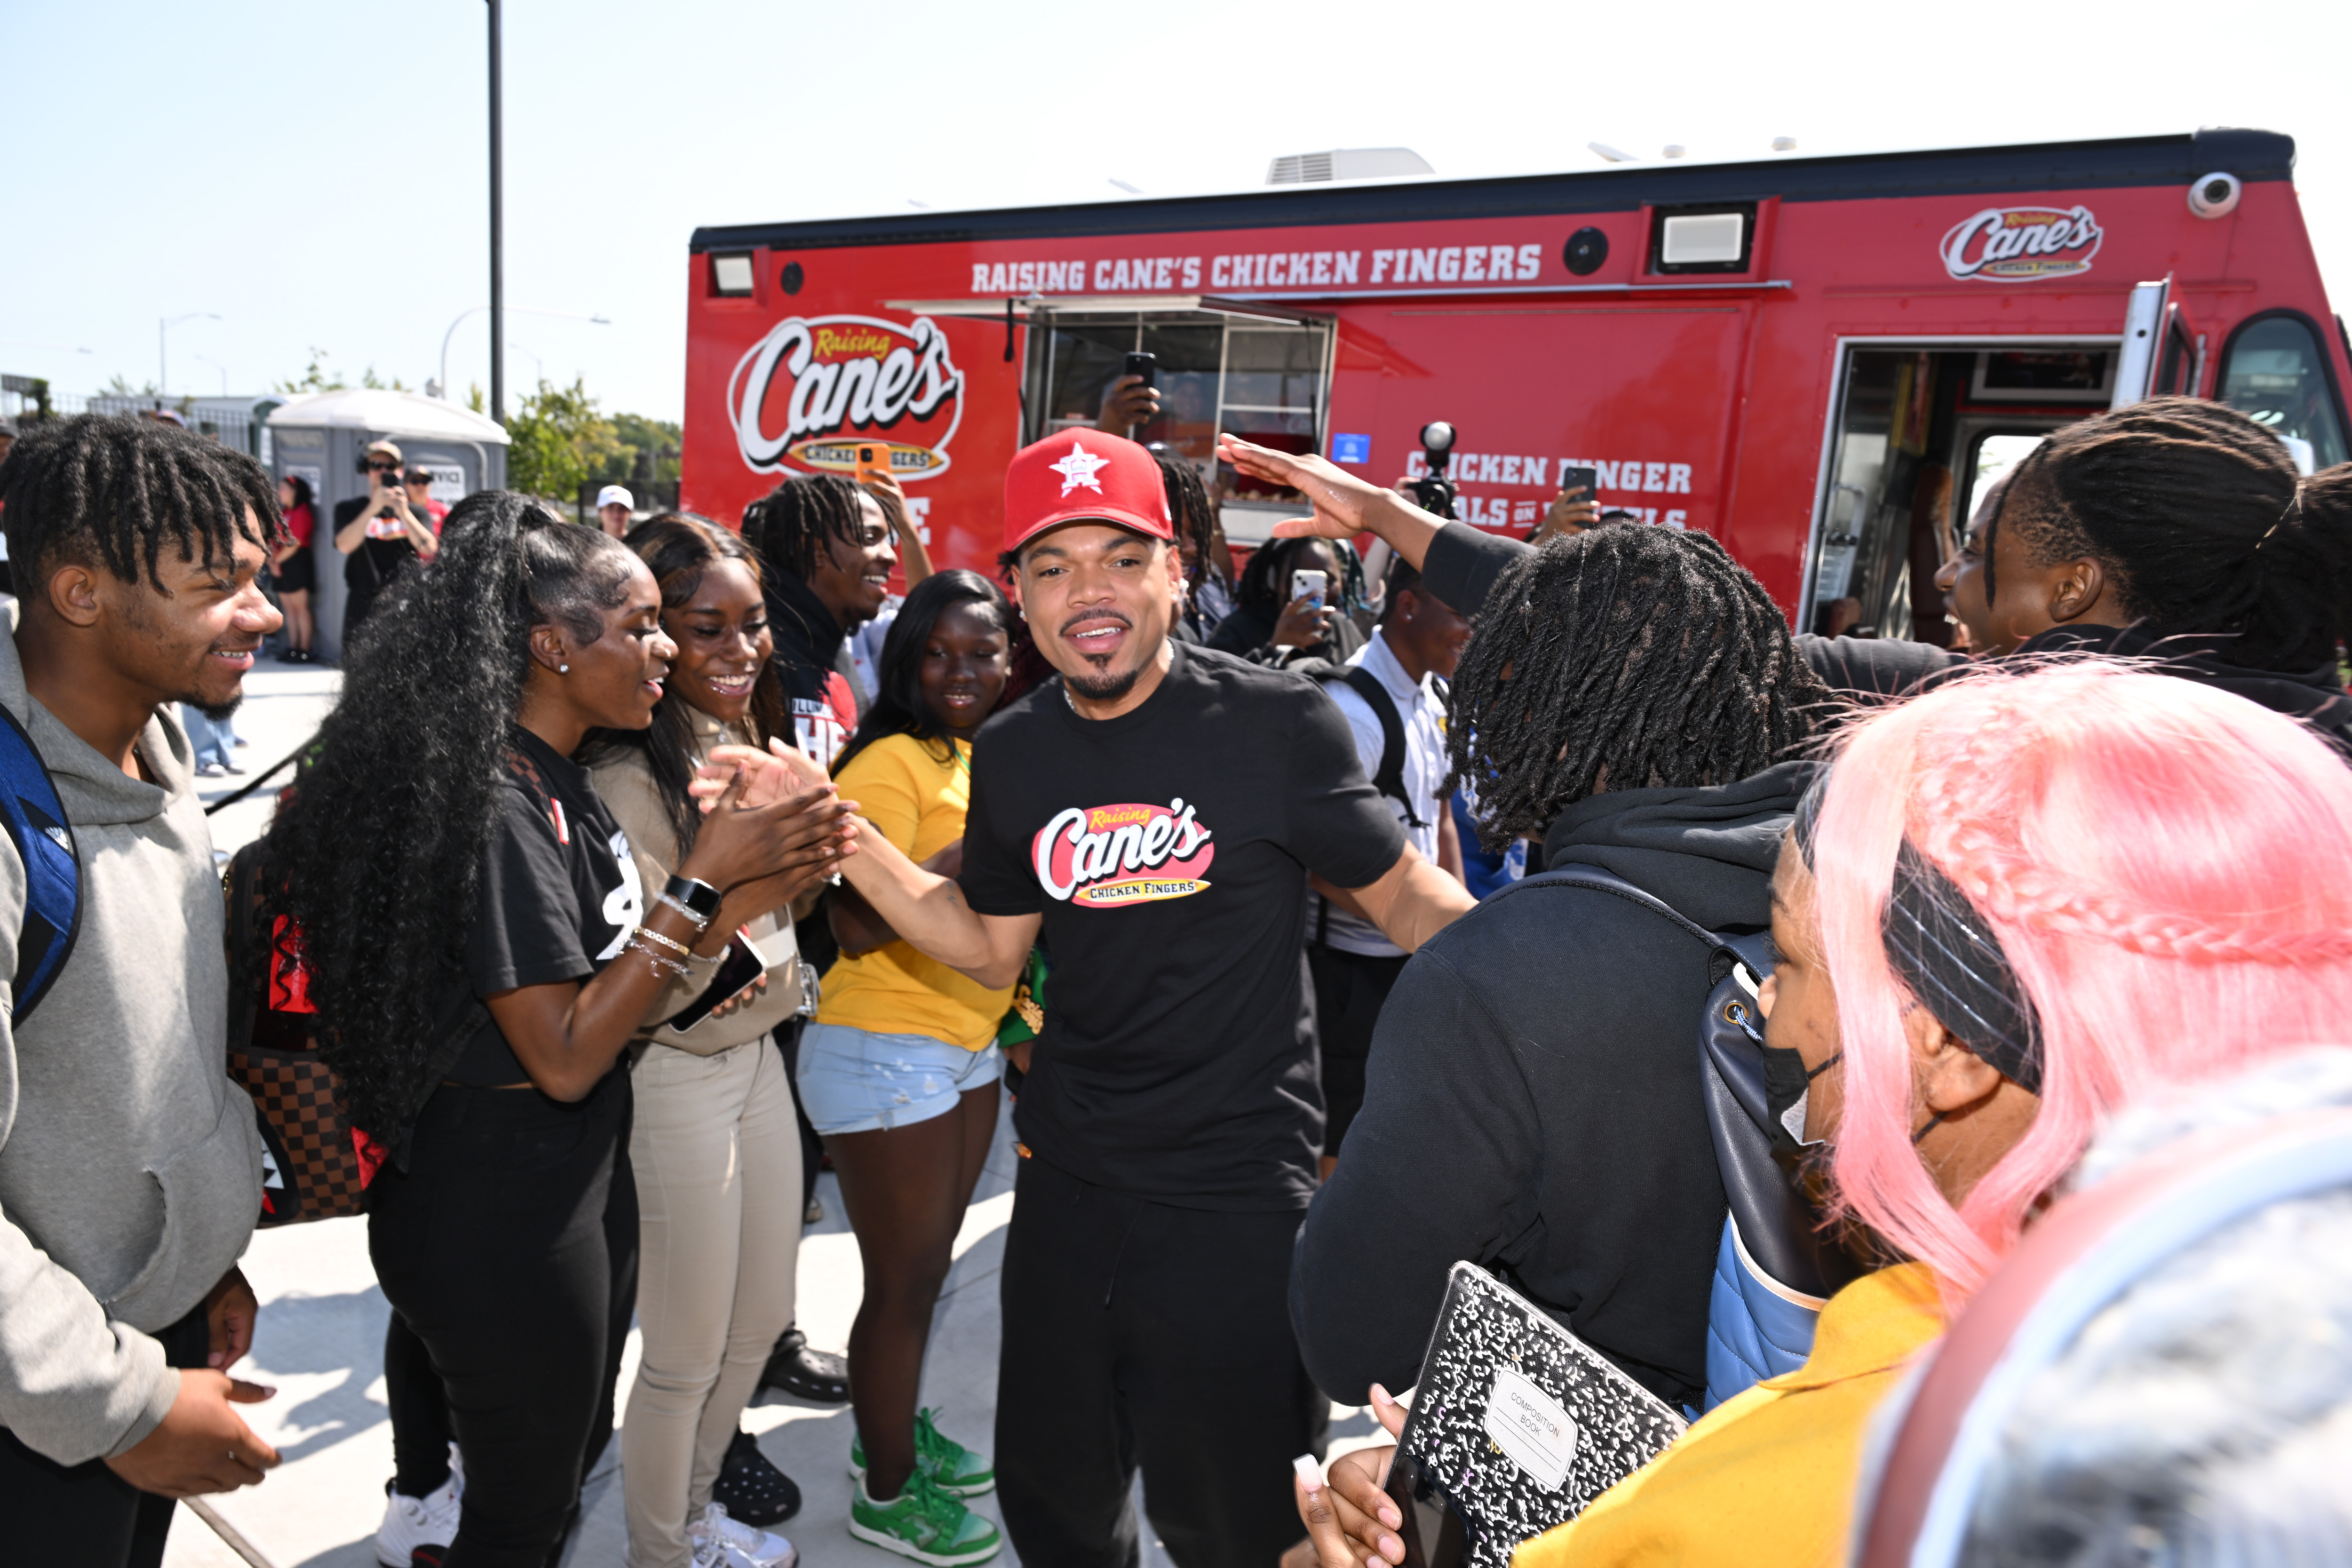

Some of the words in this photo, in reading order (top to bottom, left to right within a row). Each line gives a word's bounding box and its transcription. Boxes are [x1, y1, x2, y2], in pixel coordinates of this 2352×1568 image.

[1948, 207, 2101, 276] Cane's
[970, 260, 1085, 293] RAISING
[1094, 256, 1202, 290] CANE'S
[1211, 250, 1361, 287] CHICKEN
[1369, 244, 1542, 283] FINGERS
[814, 328, 891, 360] Raising
[740, 320, 958, 462] Cane's
[806, 445, 856, 462] CHICKE
[1406, 451, 1548, 486] CICKEN
[1556, 458, 1692, 494] FNGER
[1513, 507, 1537, 522] ON
[1089, 806, 1151, 829] Raising
[1037, 797, 1212, 901] Cane's
[1090, 884, 1140, 899] CHICKEN
[1144, 882, 1195, 894] FINGERS
[1511, 1392, 1560, 1437] COMPOSITION
[1520, 1414, 1542, 1437] BOOK
